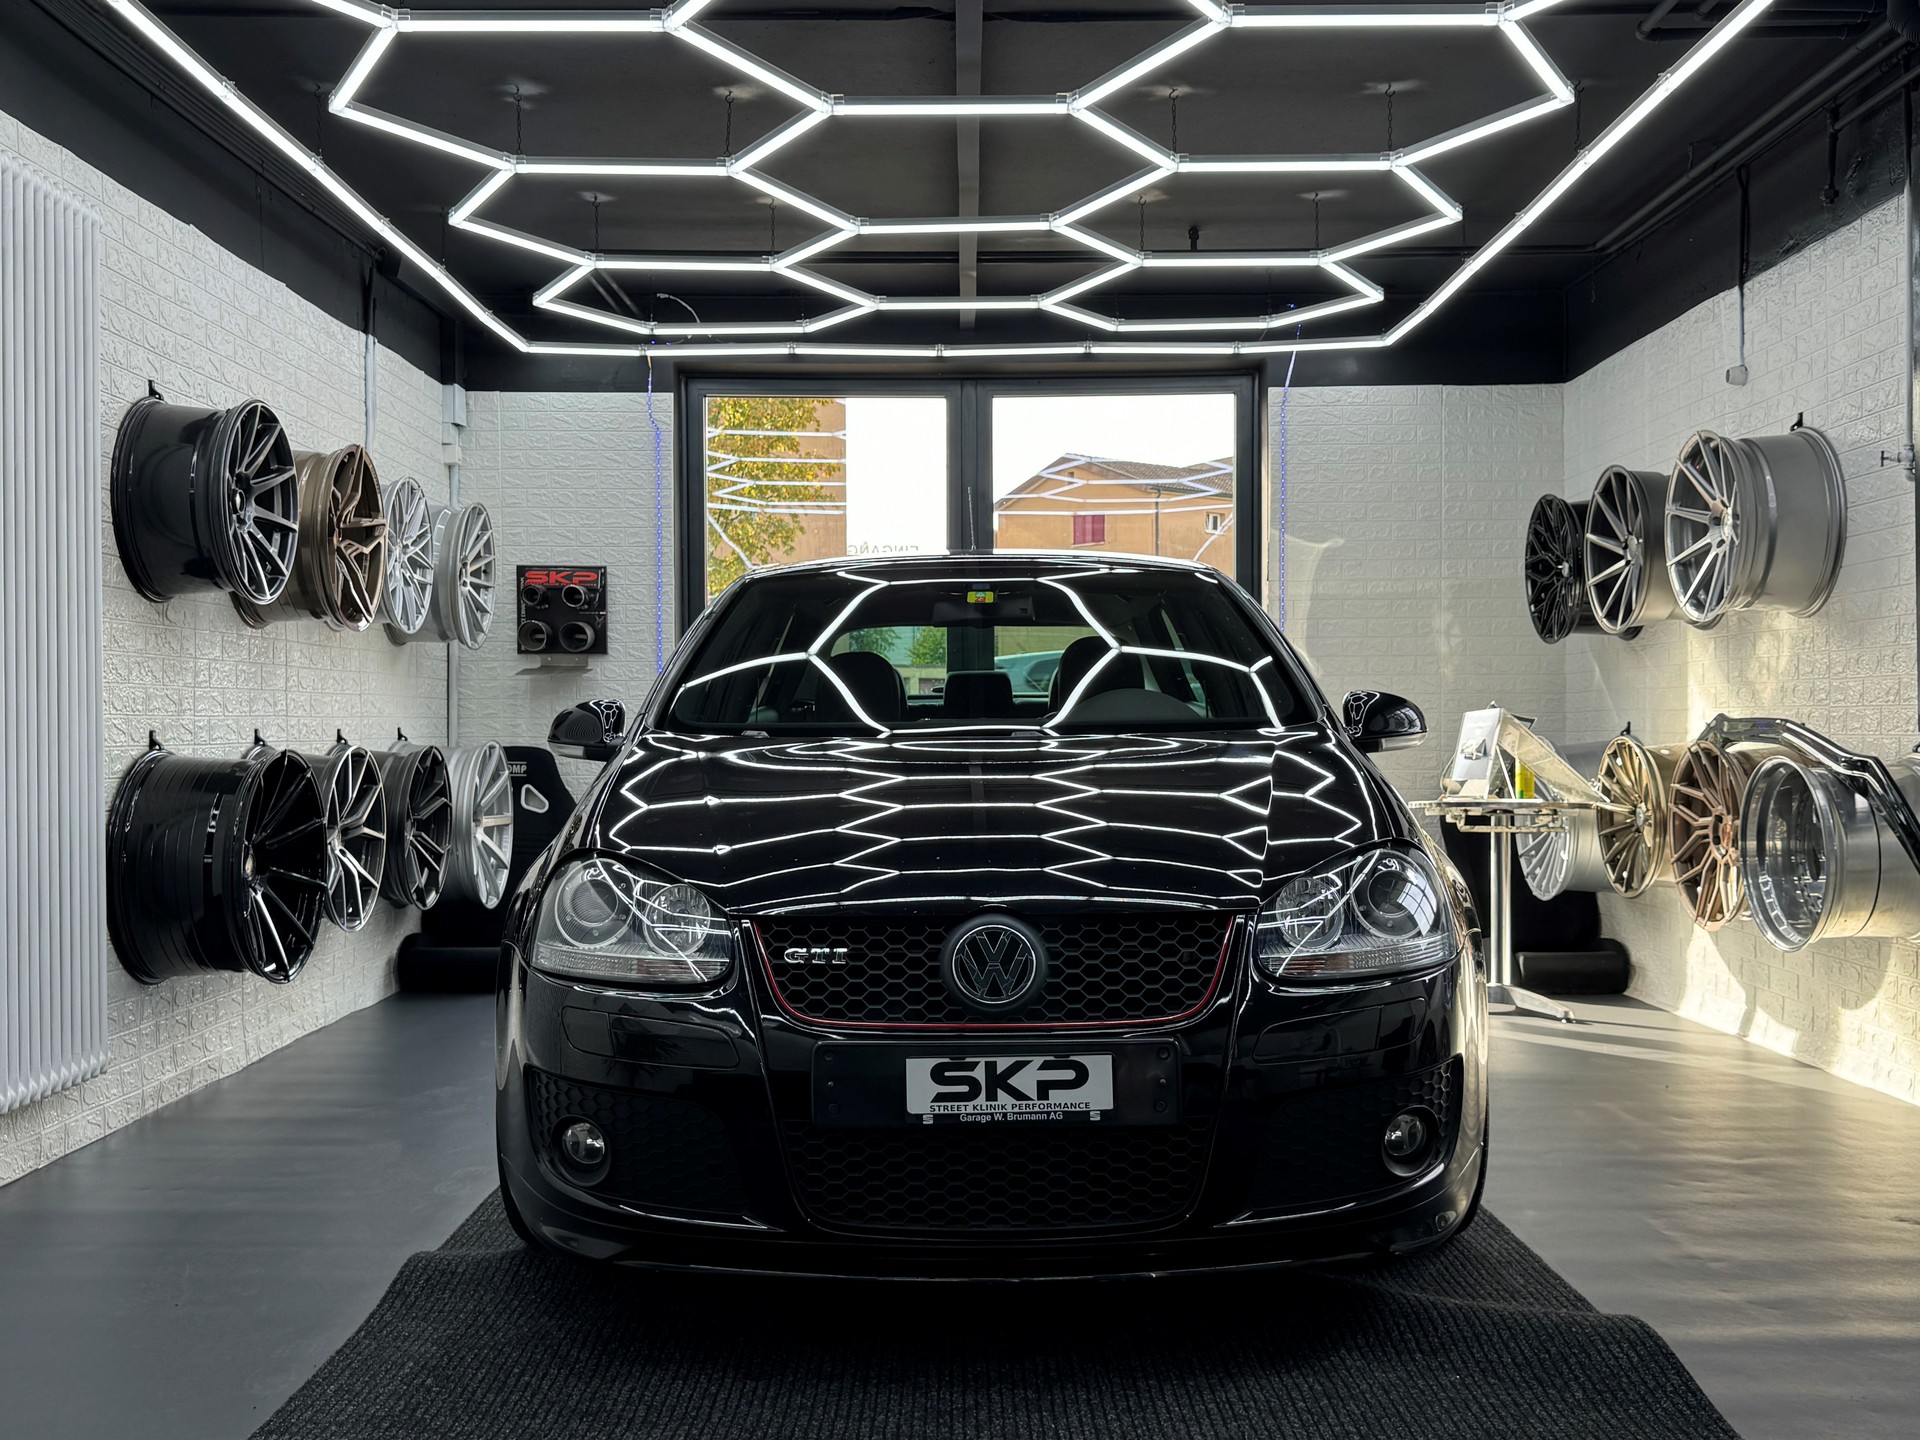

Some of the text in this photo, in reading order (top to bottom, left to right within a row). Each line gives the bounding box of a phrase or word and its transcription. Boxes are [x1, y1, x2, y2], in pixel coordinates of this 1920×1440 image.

[525, 571, 598, 585] SKP
[784, 947, 848, 964] GTI
[930, 1059, 1090, 1103] SKP
[930, 1102, 1091, 1113] STREET KLINIK PERFORMANCE
[959, 1111, 1063, 1123] Garage W. Brumann AG
